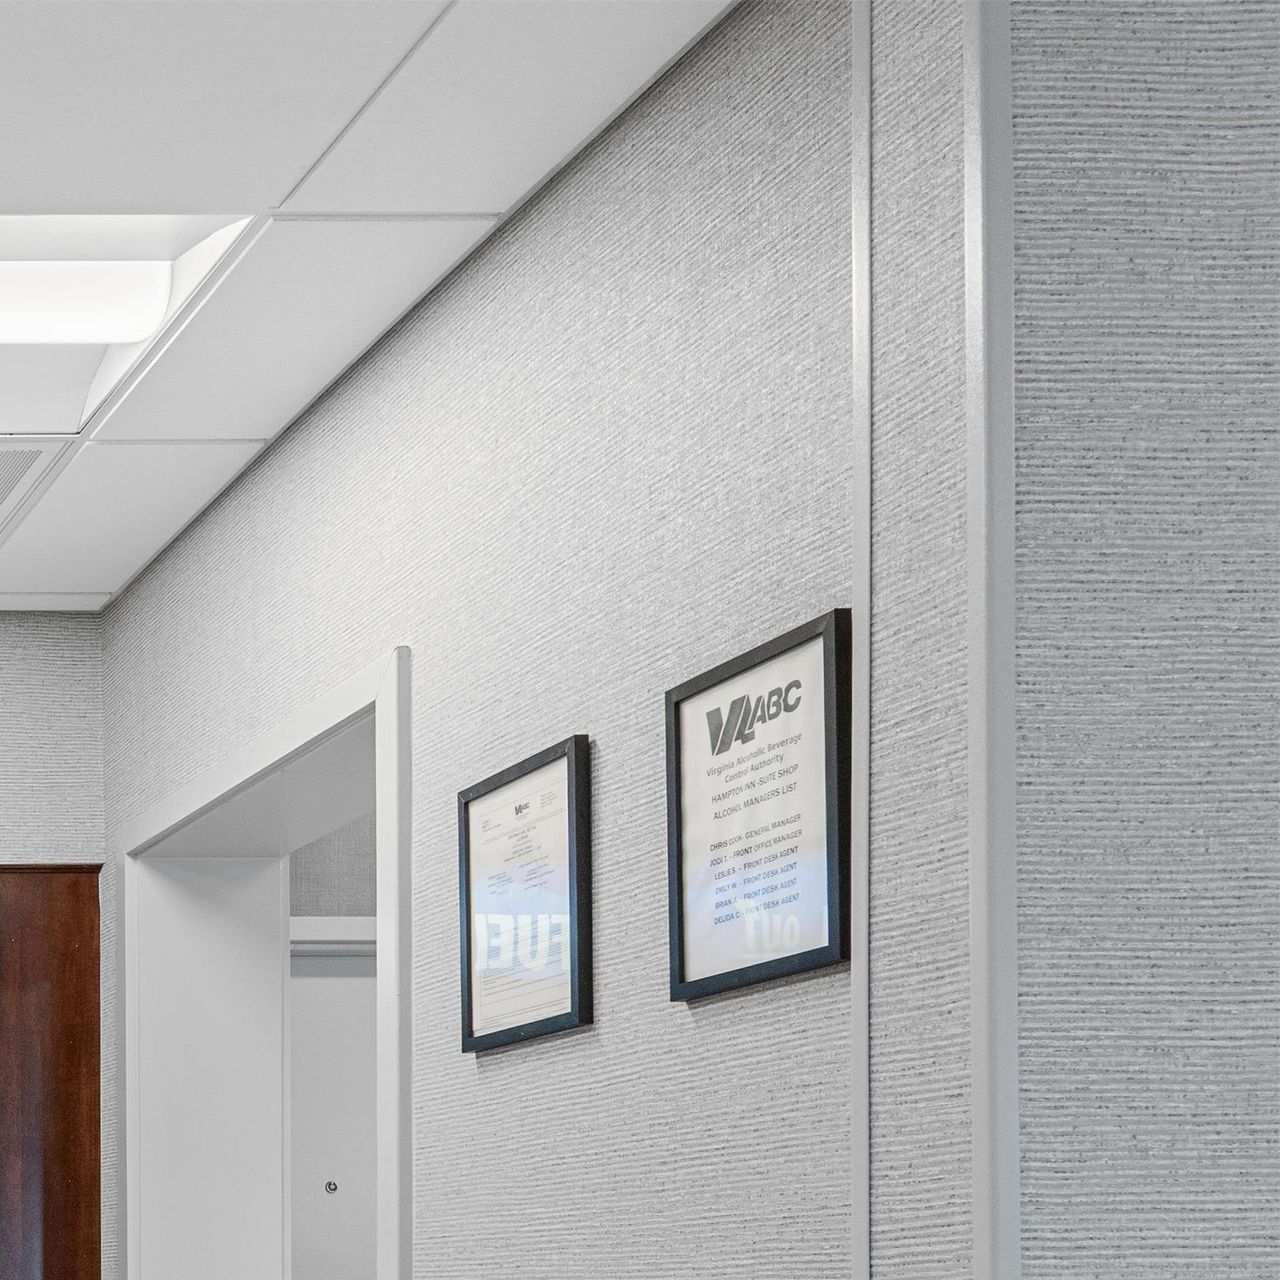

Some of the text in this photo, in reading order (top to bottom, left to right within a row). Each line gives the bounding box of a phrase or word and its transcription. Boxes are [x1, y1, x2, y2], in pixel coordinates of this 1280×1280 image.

[747, 679, 802, 731] ABC
[707, 733, 803, 777] Virginia Alcoholic Beverage
[724, 752, 785, 783] Control Authority
[711, 787, 743, 804] HAMPTON
[777, 764, 799, 779] SHOP
[713, 781, 798, 820] ALCOHOL MANAGERS LIST
[709, 813, 802, 852] CHRIS GENERAL MANAGER
[733, 846, 753, 859] FRONT
[753, 838, 773, 852] OFFICE
[772, 829, 803, 843] MANAGER
[743, 858, 762, 871] FRONT
[763, 852, 779, 864] DESK
[779, 845, 800, 858] AGENT
[743, 873, 762, 887] FRONT
[762, 868, 779, 880] DESK
[779, 861, 798, 875] AGENT
[743, 889, 762, 903] FRONT
[762, 884, 779, 897] DESK
[779, 877, 798, 890] AGENT
[763, 899, 780, 911] DESK
[780, 892, 800, 905] AGENT
